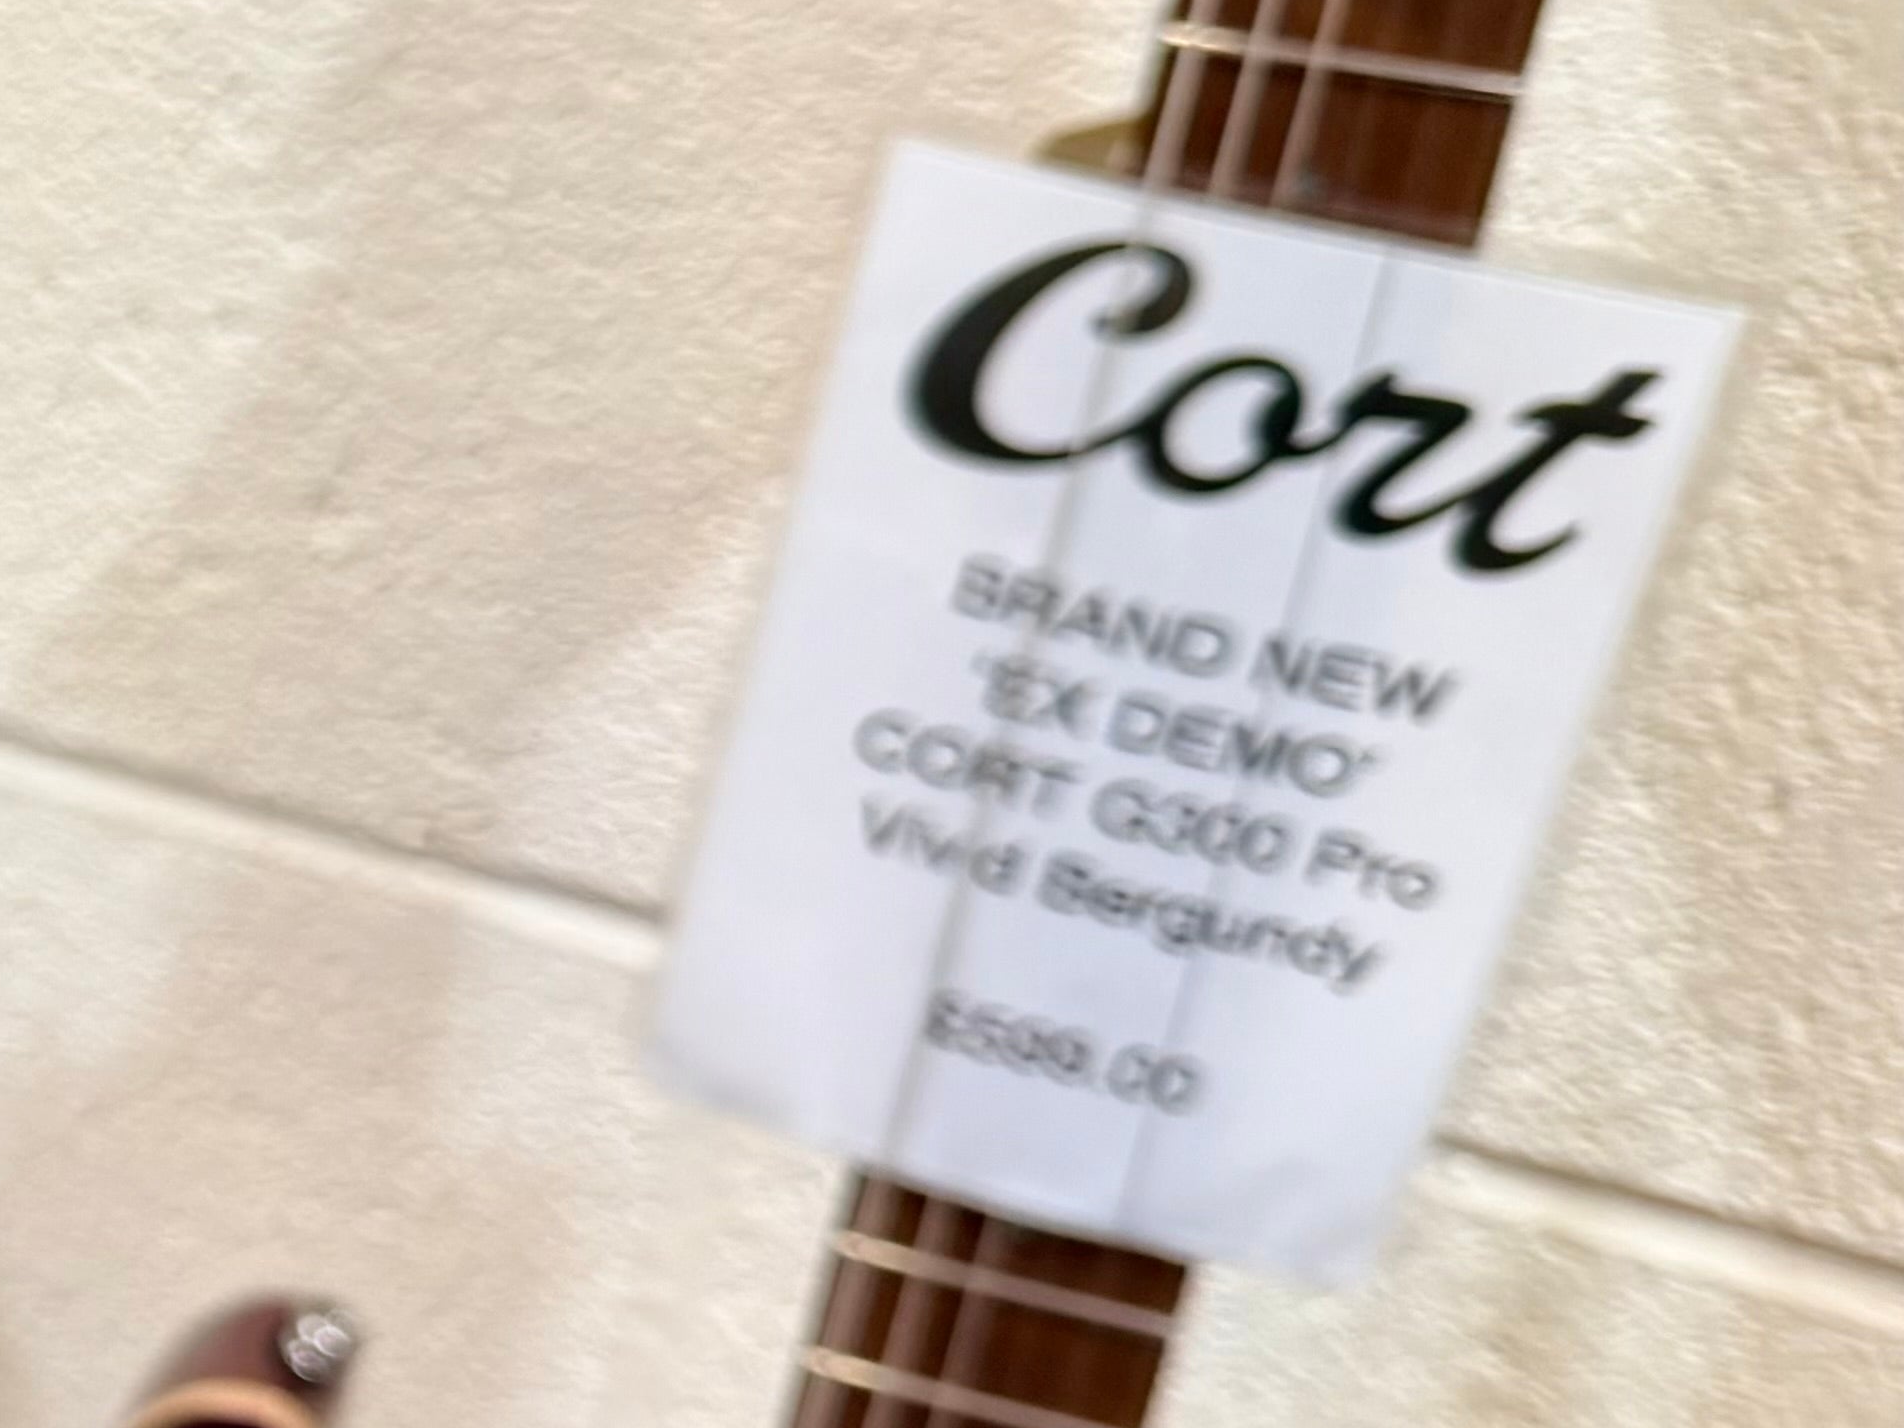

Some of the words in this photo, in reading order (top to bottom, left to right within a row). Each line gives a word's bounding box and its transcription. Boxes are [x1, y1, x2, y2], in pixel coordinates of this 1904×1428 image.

[900, 234, 1669, 577] Cort
[948, 554, 1236, 682] BRAND
[1254, 628, 1460, 724] NEW
[852, 708, 1084, 816] CORT
[1092, 772, 1294, 876] G300
[1304, 830, 1444, 914] Pro
[856, 792, 1026, 898] Vivid
[1036, 850, 1386, 996] Bergundy
